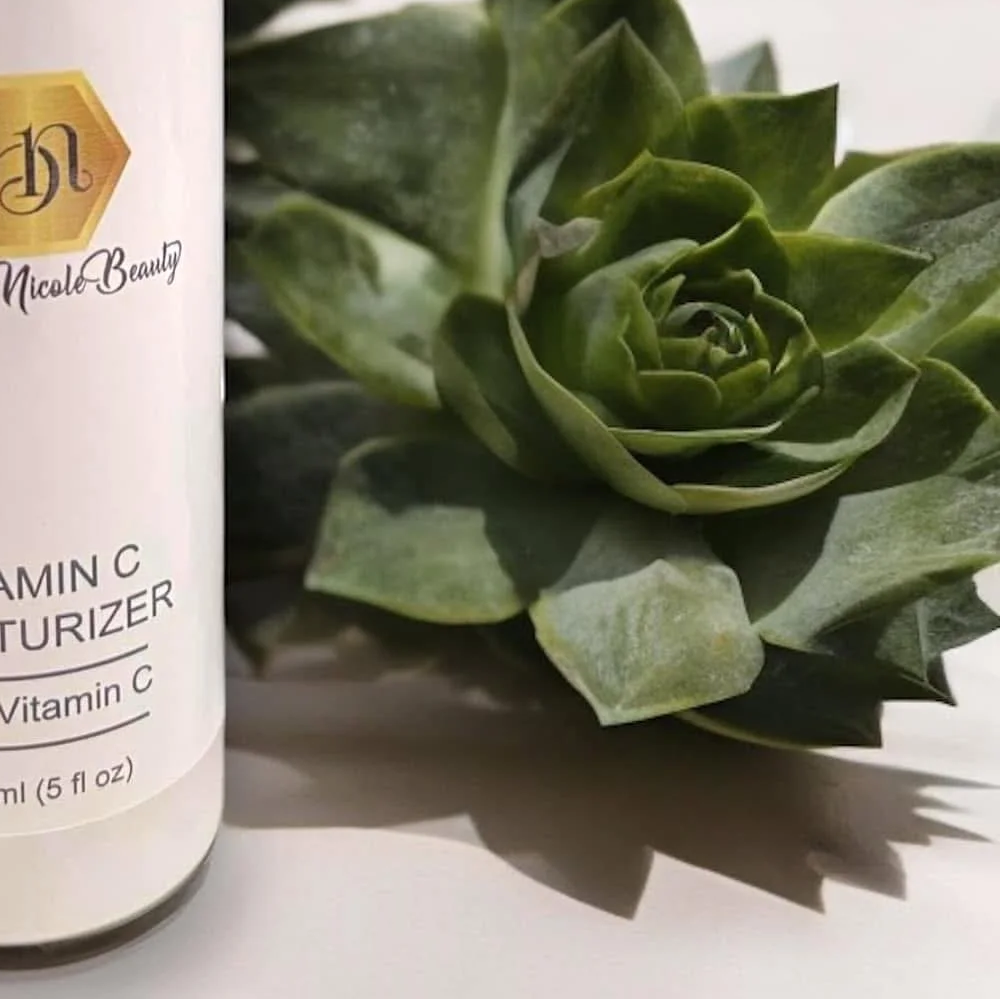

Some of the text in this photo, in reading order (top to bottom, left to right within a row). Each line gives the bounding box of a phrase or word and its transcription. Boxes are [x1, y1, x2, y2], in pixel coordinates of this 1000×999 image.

[79, 240, 182, 294] Beauty
[113, 544, 140, 579] C
[132, 664, 153, 694] C
[36, 777, 63, 807] (5
[71, 771, 86, 794] fl
[95, 756, 134, 787] oz)
